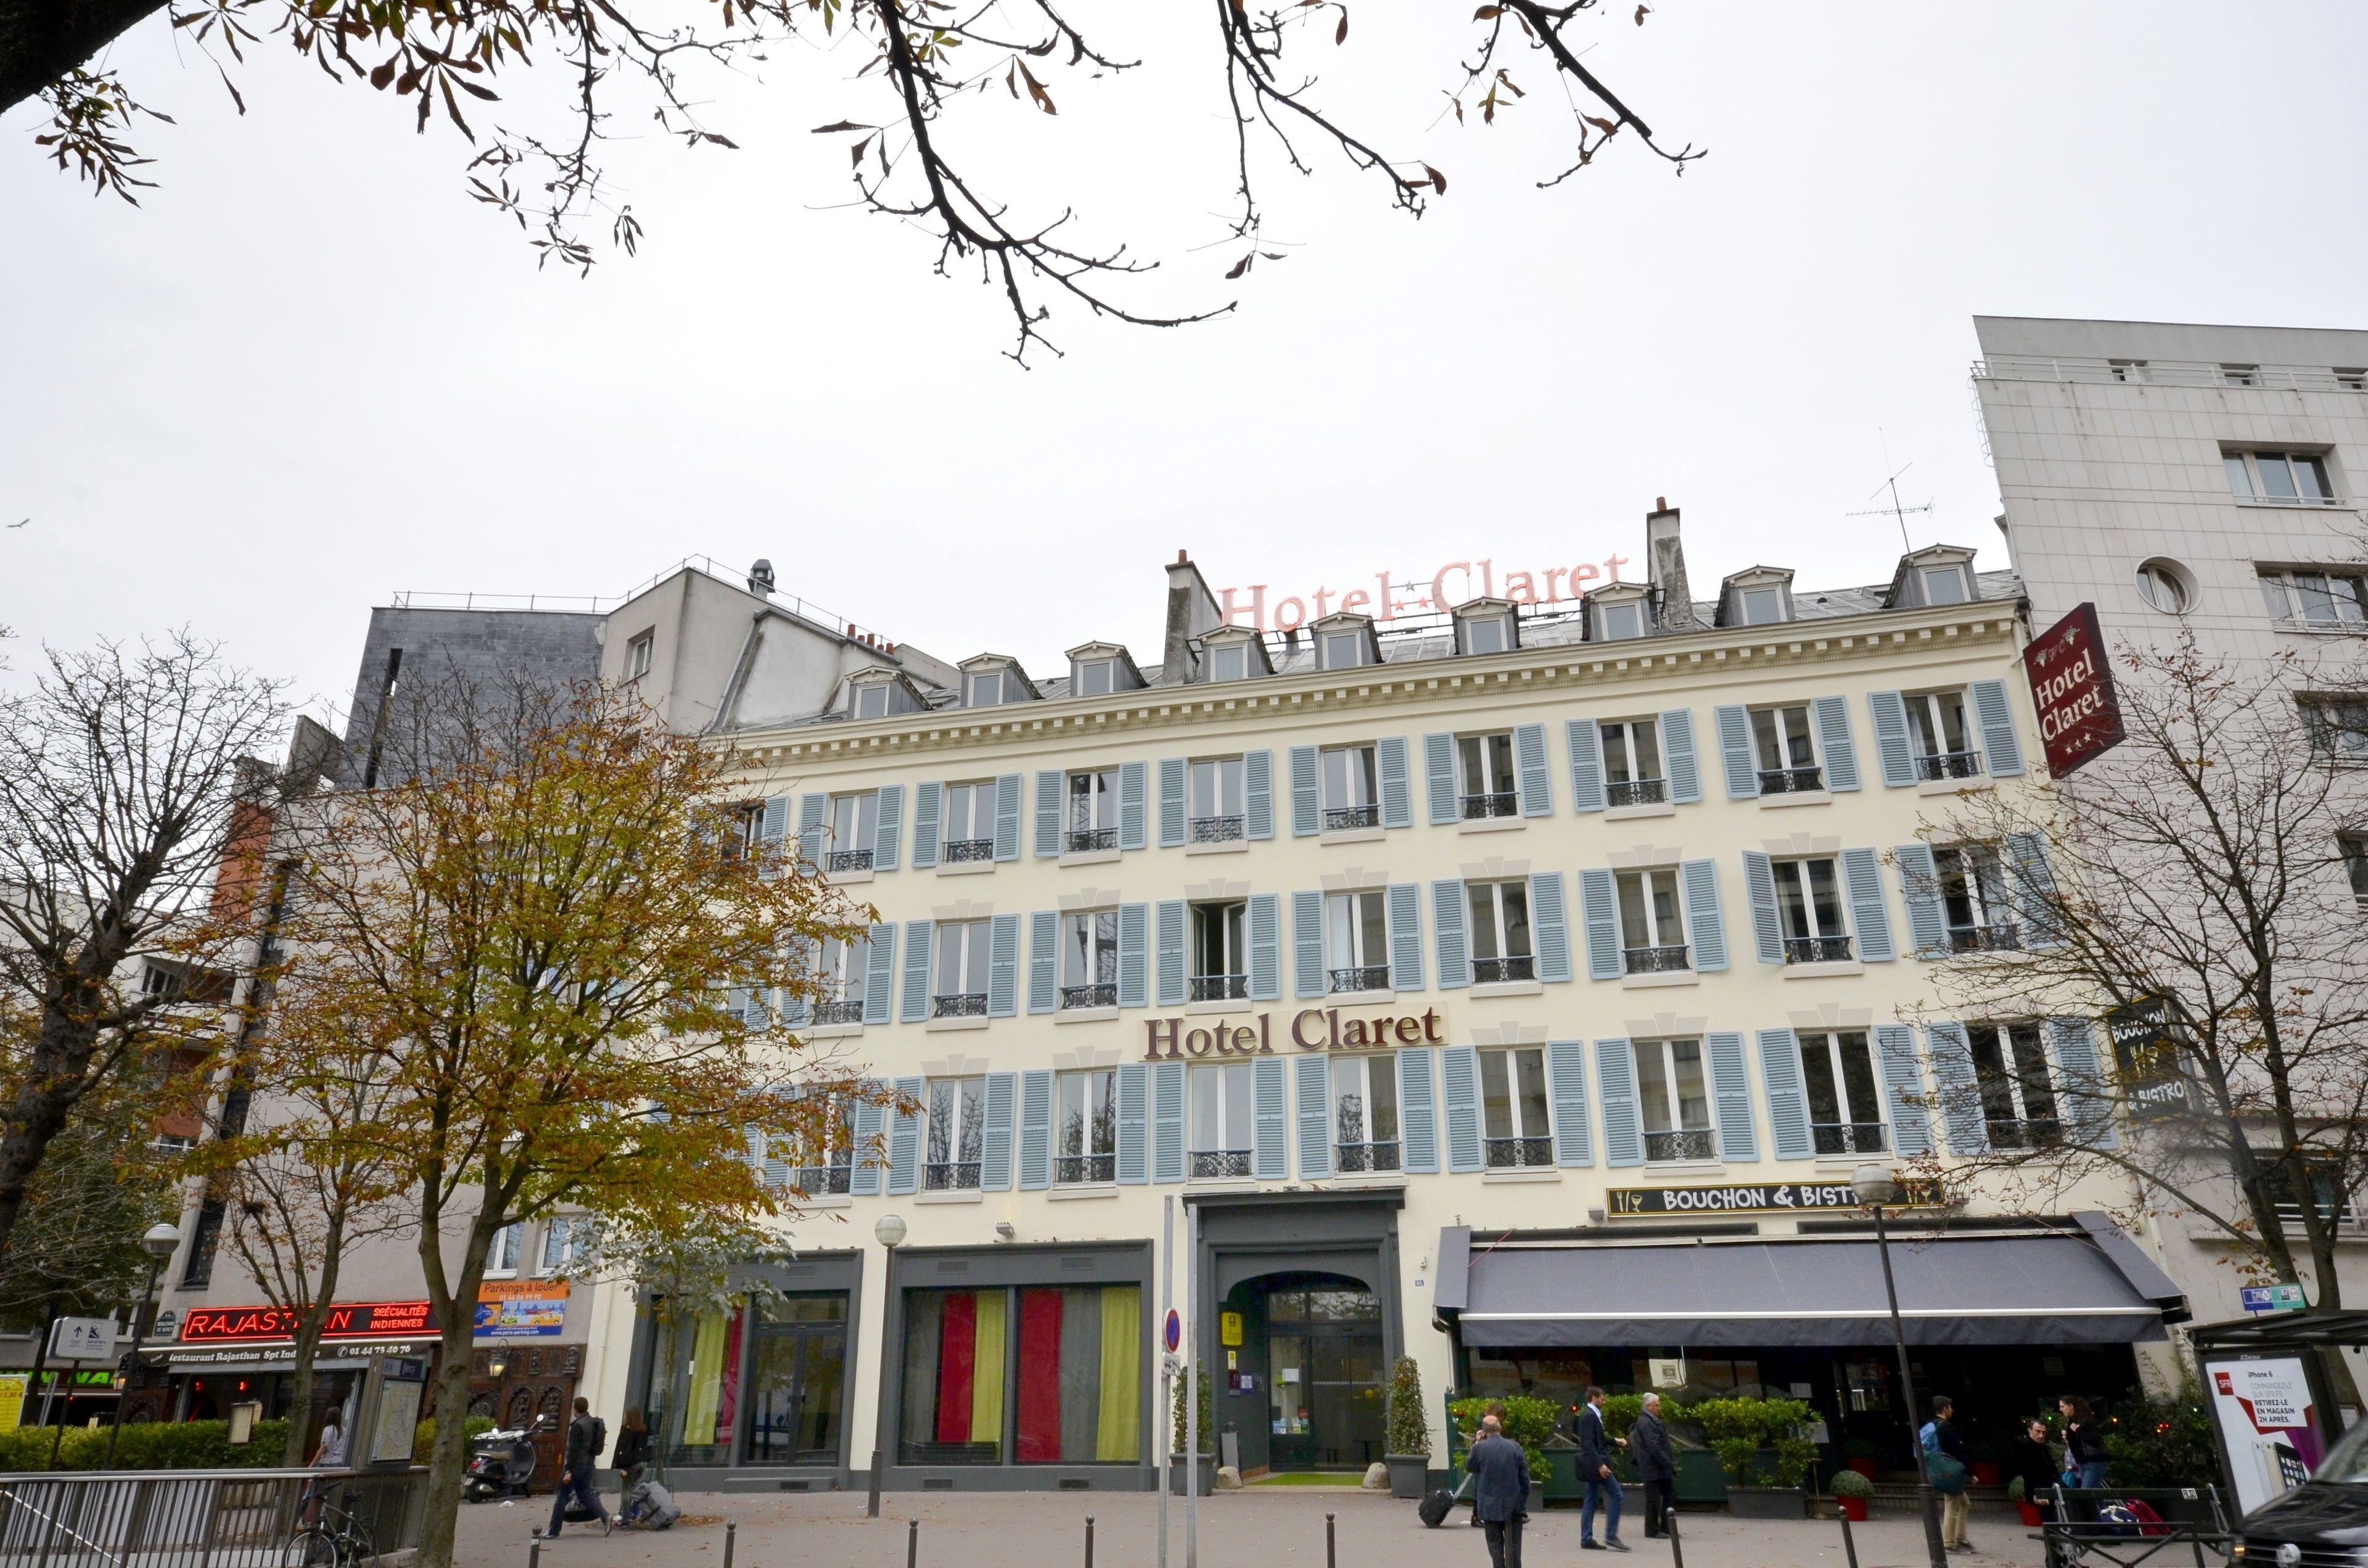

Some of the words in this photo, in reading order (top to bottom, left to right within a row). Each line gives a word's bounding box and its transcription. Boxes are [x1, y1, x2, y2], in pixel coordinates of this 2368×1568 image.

[1217, 570, 1396, 633] Hotel
[1431, 553, 1629, 614] Claret
[2036, 647, 2095, 710] Hotel
[2042, 684, 2103, 741] Claret
[1144, 1012, 1273, 1060] Hotel
[1291, 1006, 1442, 1049] Claret
[2138, 1081, 2185, 1110] BISTRO
[1664, 1188, 1766, 1211] BOUCHON
[1773, 1184, 1797, 1209] &
[484, 1283, 525, 1294] Parkings
[527, 1282, 532, 1291] à
[535, 1282, 559, 1292] louer
[372, 1305, 428, 1317] SPÉCIALITÉS
[370, 1318, 424, 1329] INDIENNES
[216, 1352, 260, 1363] Rajasthan
[263, 1350, 279, 1360] Spt
[349, 1347, 360, 1355] 01
[361, 1347, 373, 1355] 44
[374, 1346, 385, 1355] 73
[387, 1345, 398, 1354] 40
[400, 1345, 411, 1355] 76
[2218, 1379, 2233, 1389] SFR
